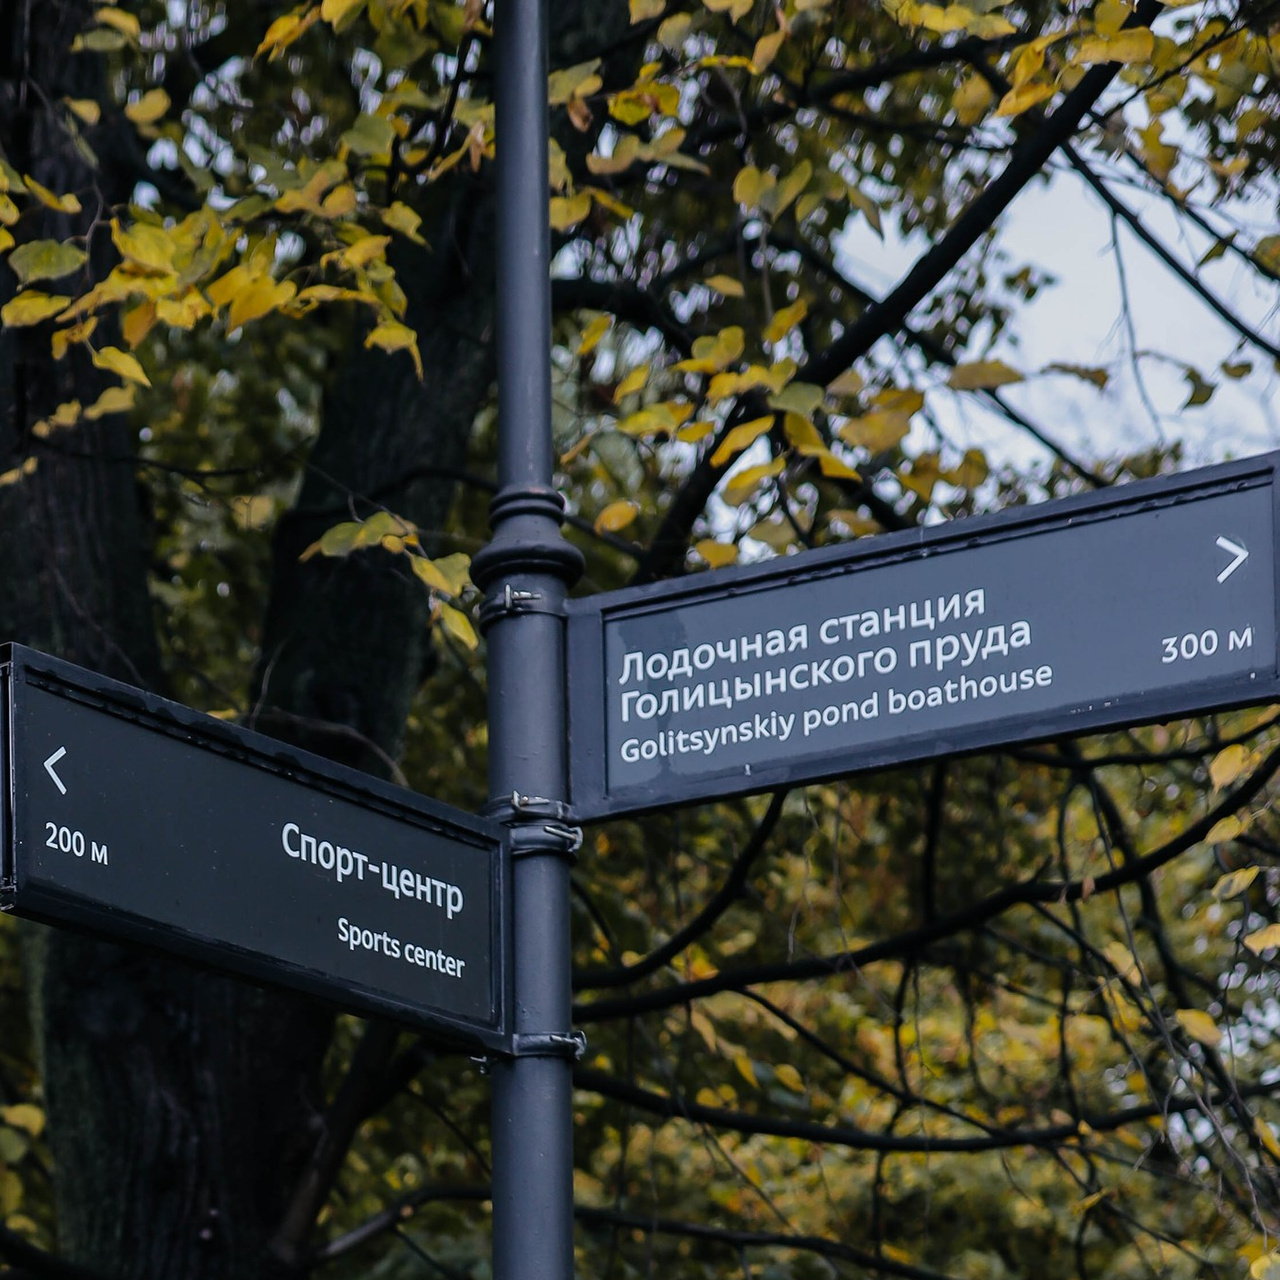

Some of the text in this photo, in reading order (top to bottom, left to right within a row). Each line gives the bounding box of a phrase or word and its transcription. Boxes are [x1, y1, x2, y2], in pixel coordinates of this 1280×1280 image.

[618, 588, 986, 685] Лодочная станция
[620, 620, 1032, 723] Голицынского пруда
[1160, 626, 1253, 664] 300 м
[619, 664, 1054, 764] Golitsynskiy pond boathouse
[44, 821, 109, 867] 200 м
[280, 822, 464, 920] Спорт-центр
[337, 916, 466, 979] Sports center
